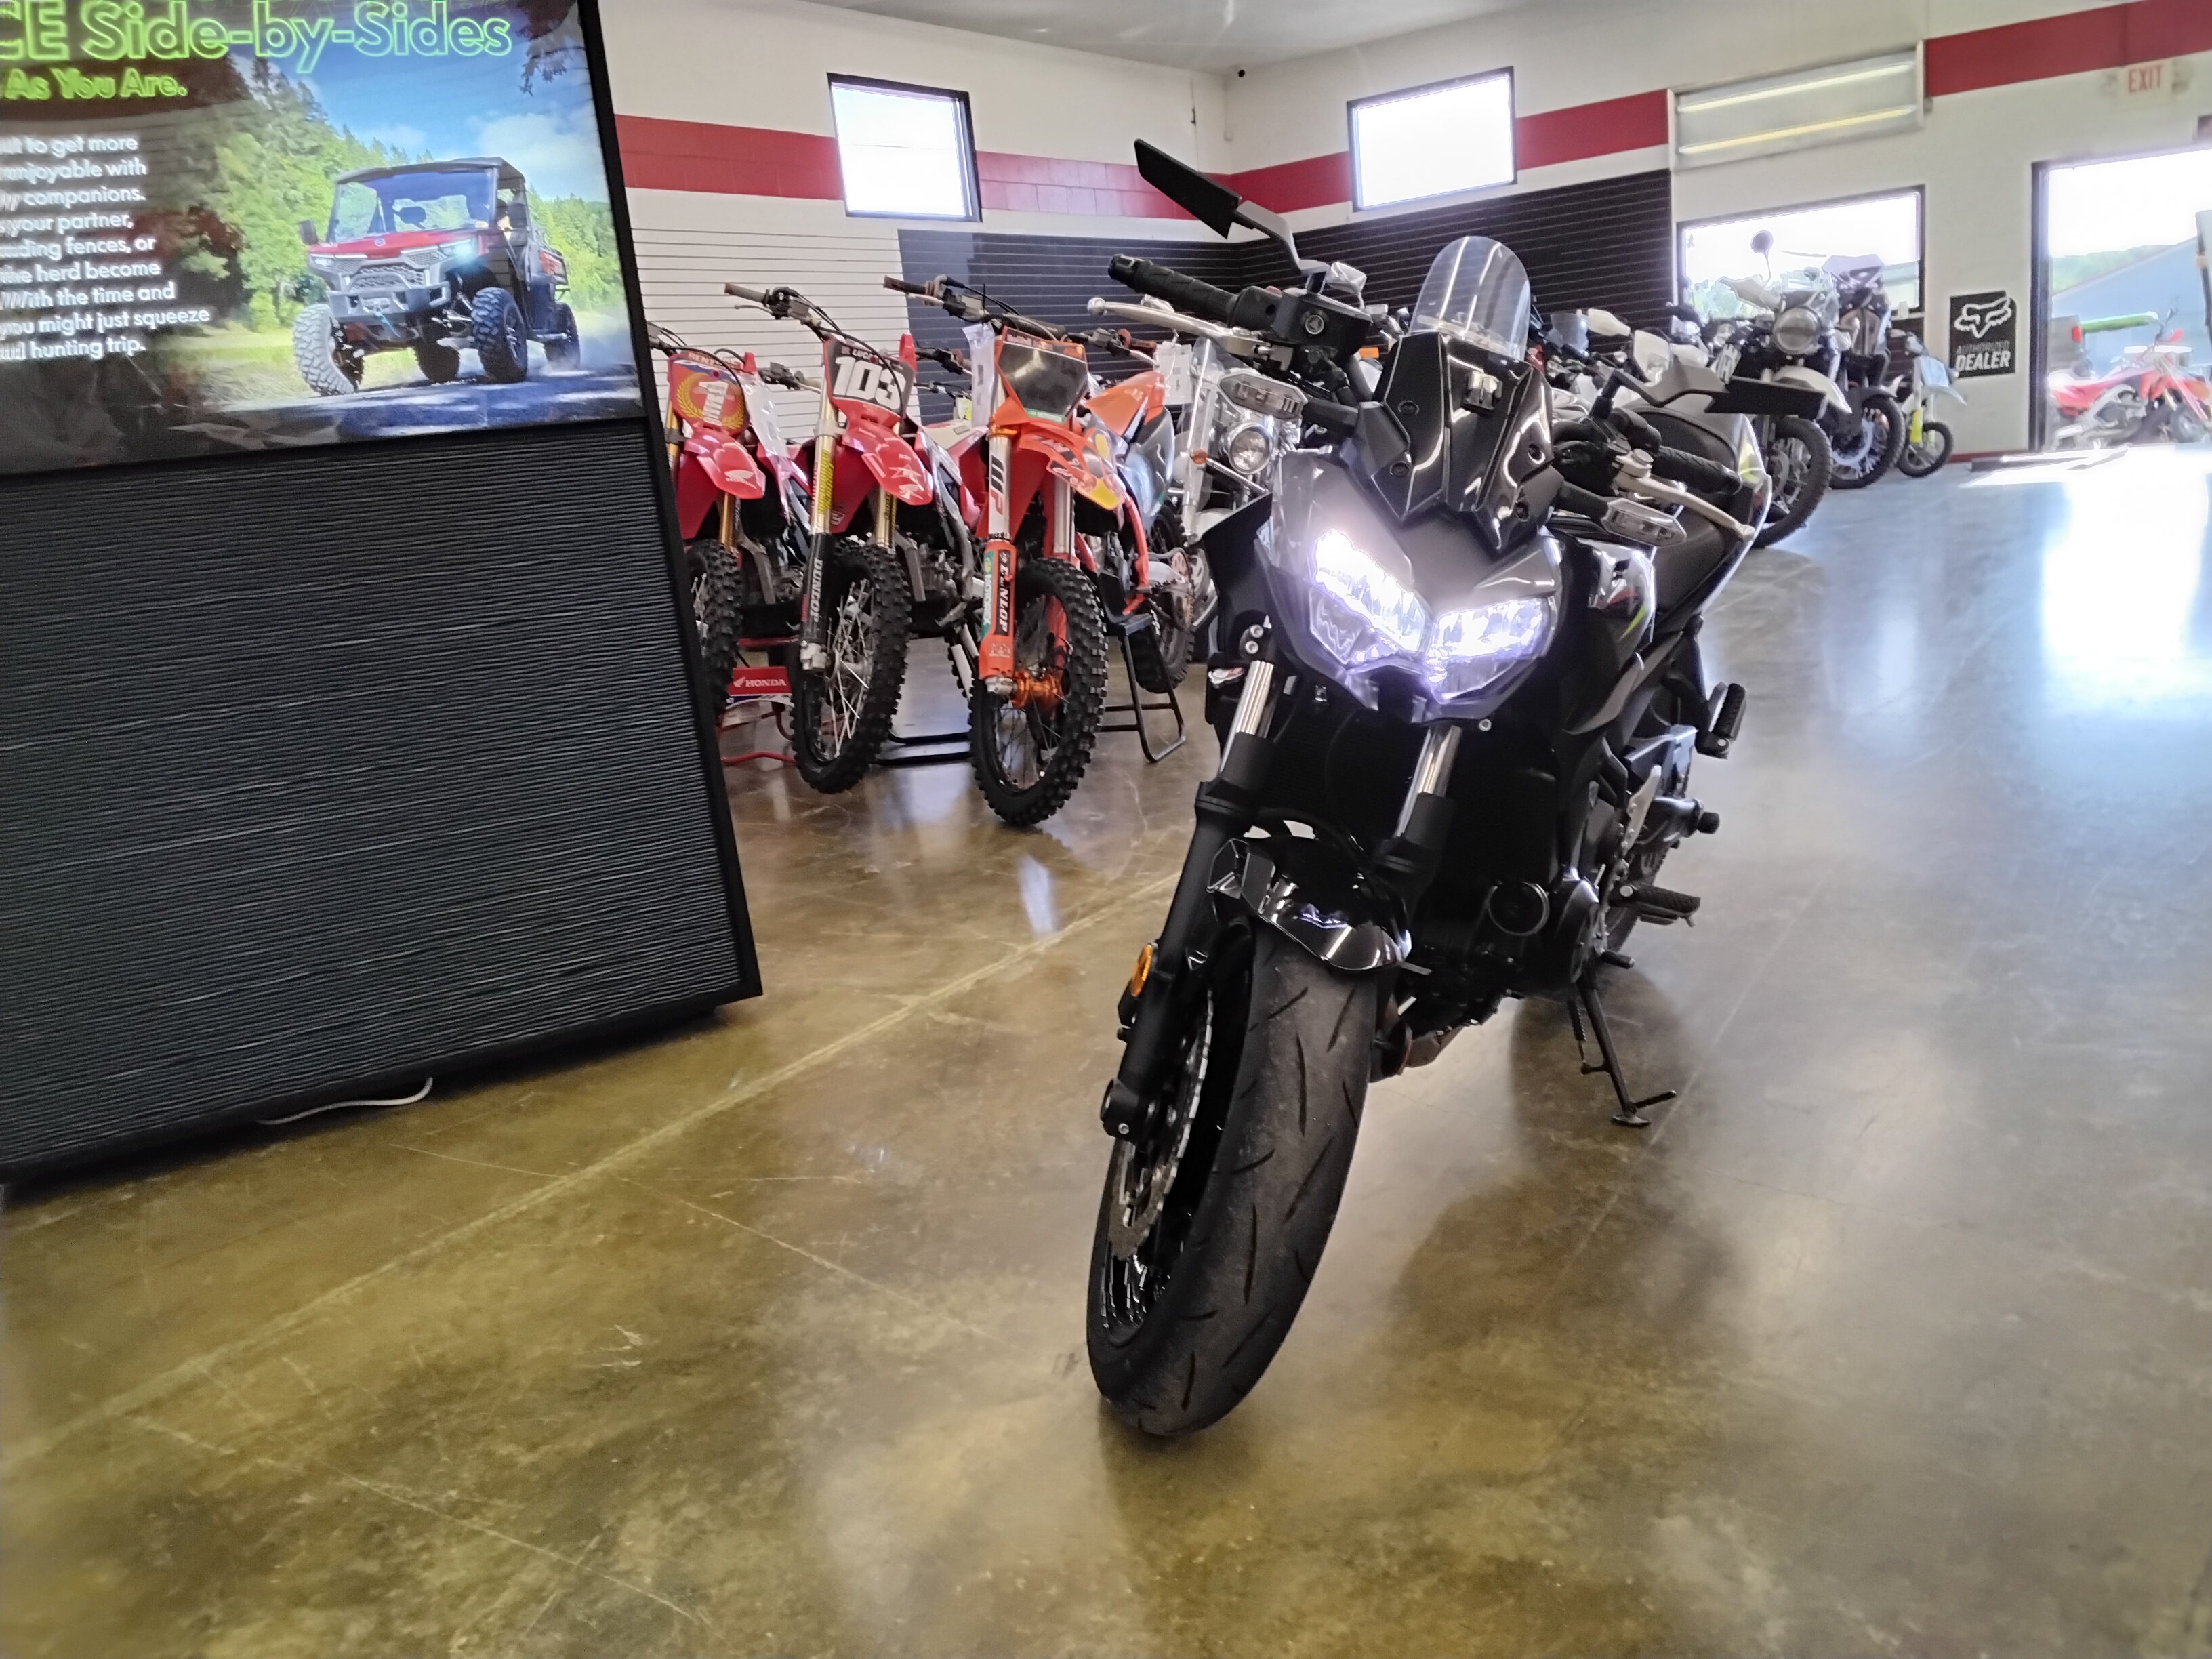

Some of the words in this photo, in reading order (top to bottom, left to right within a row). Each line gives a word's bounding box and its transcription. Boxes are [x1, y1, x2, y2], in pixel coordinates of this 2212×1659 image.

[81, 0, 512, 73] Side-by-Sides
[5, 68, 51, 100] As
[51, 67, 116, 99] You
[120, 68, 188, 98] Are.
[2128, 64, 2163, 94] EXIT
[25, 136, 47, 154] to
[51, 135, 85, 158] get
[89, 137, 138, 152] more
[105, 157, 147, 176] with
[22, 186, 146, 209] companions.
[57, 212, 134, 235] partner,
[65, 237, 132, 255] fences,
[135, 238, 157, 251] or
[35, 261, 80, 282] herd
[84, 260, 161, 280] become
[56, 287, 89, 305] the
[91, 285, 134, 304] time
[138, 281, 175, 300] and
[38, 312, 94, 336] might
[96, 311, 129, 333] just
[133, 308, 210, 331] squeeze
[30, 340, 102, 360] hunting
[106, 335, 146, 356] trip.
[1955, 350, 2011, 371] DEALER
[832, 356, 907, 411] 103
[698, 380, 729, 426] 1
[810, 557, 823, 623] DUNLOP
[998, 563, 1009, 633] DNLOP
[745, 678, 787, 687] HONDA
